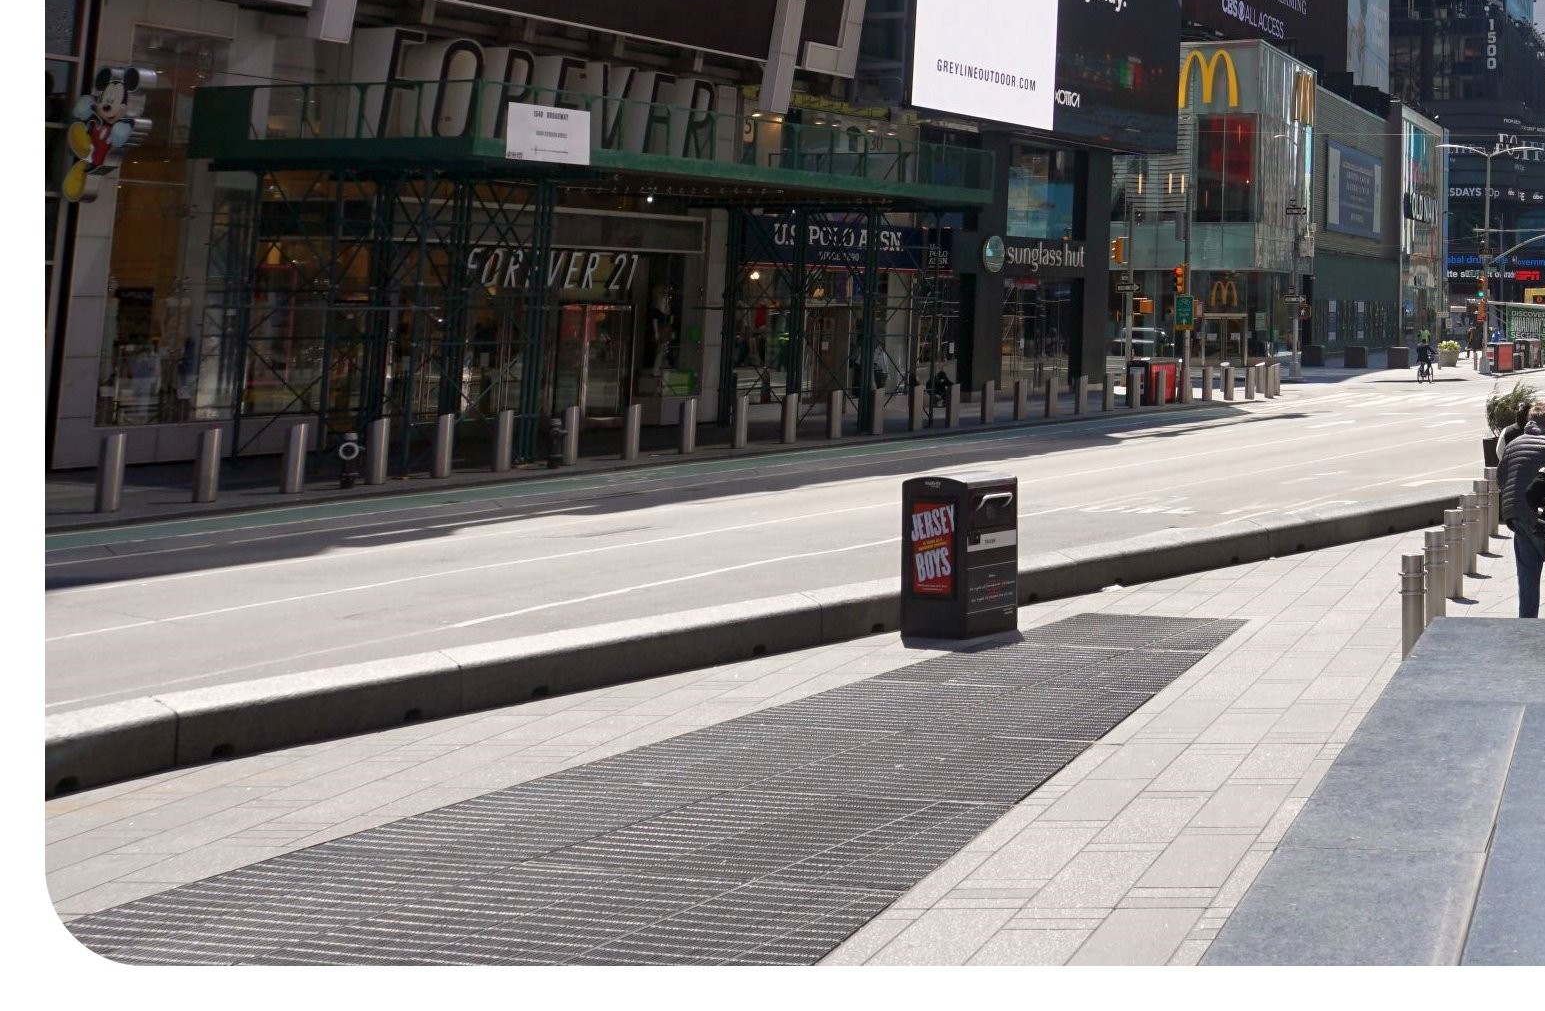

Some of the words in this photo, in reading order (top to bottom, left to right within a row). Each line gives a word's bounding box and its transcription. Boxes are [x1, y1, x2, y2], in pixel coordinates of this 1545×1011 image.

[1245, 6, 1258, 28] ALL
[1258, 11, 1285, 39] ACCESS
[1486, 18, 1497, 70] 1500
[937, 59, 1037, 91] GREYLINEOUTDOOR.COM
[466, 247, 600, 290] FORVER
[608, 254, 640, 291] 21
[1006, 241, 1062, 273] sunglass
[1064, 242, 1086, 269] hut
[911, 503, 957, 542] JERSEY
[915, 546, 952, 583] BOYS
